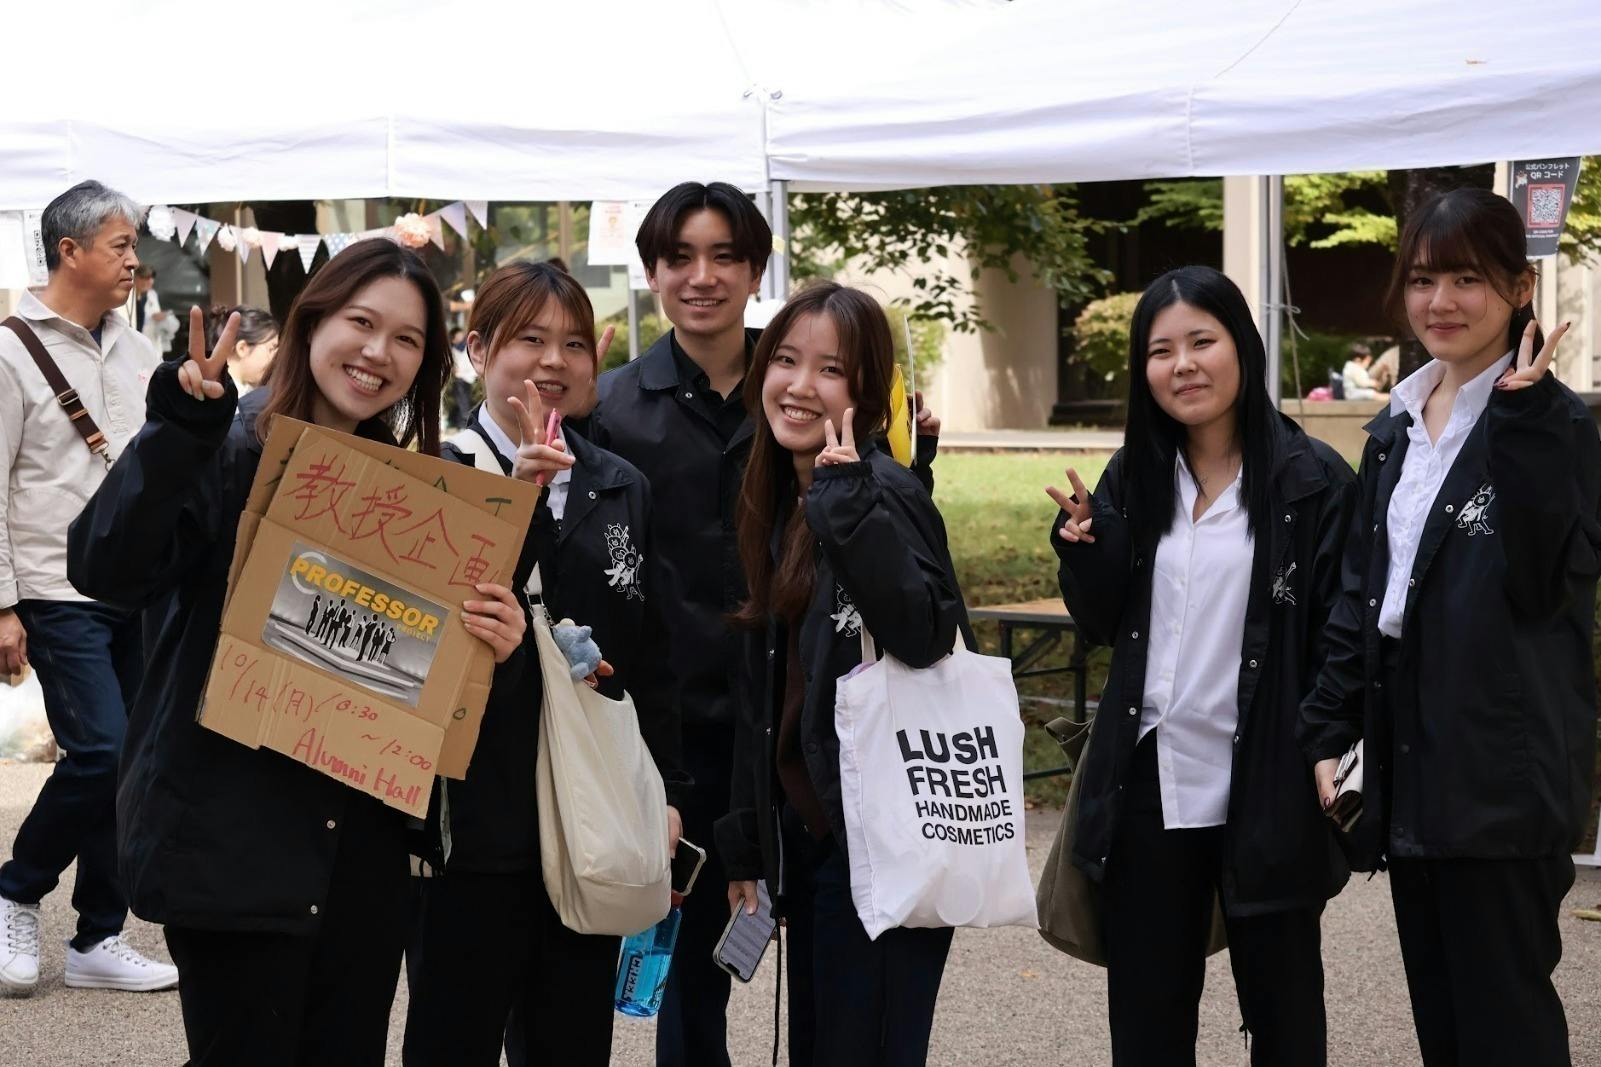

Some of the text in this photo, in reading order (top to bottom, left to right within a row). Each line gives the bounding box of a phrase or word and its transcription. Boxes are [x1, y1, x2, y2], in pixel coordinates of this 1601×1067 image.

[284, 453, 498, 586] 教授企画
[289, 553, 440, 637] PROFESSOR
[896, 725, 998, 764] LUSH
[291, 727, 421, 806] Alumni Hall
[906, 764, 1007, 799] FRESH
[915, 799, 1013, 822] HANDMADE
[922, 822, 1015, 846] COSMETICS
